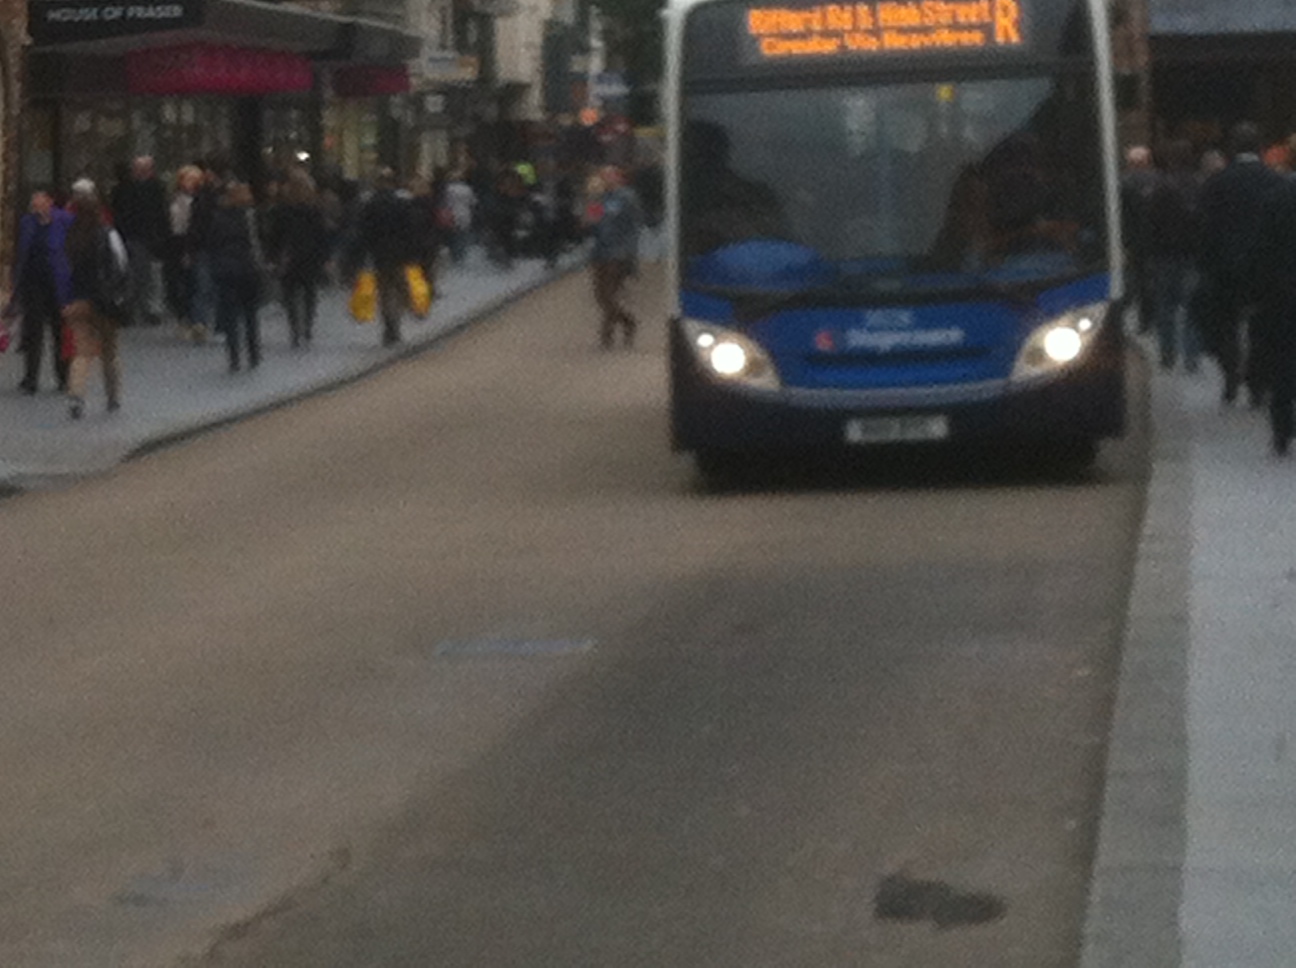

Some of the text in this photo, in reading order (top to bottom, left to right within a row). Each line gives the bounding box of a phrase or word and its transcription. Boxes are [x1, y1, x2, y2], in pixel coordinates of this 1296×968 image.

[46, 4, 184, 22] HOUSE OF FRASER
